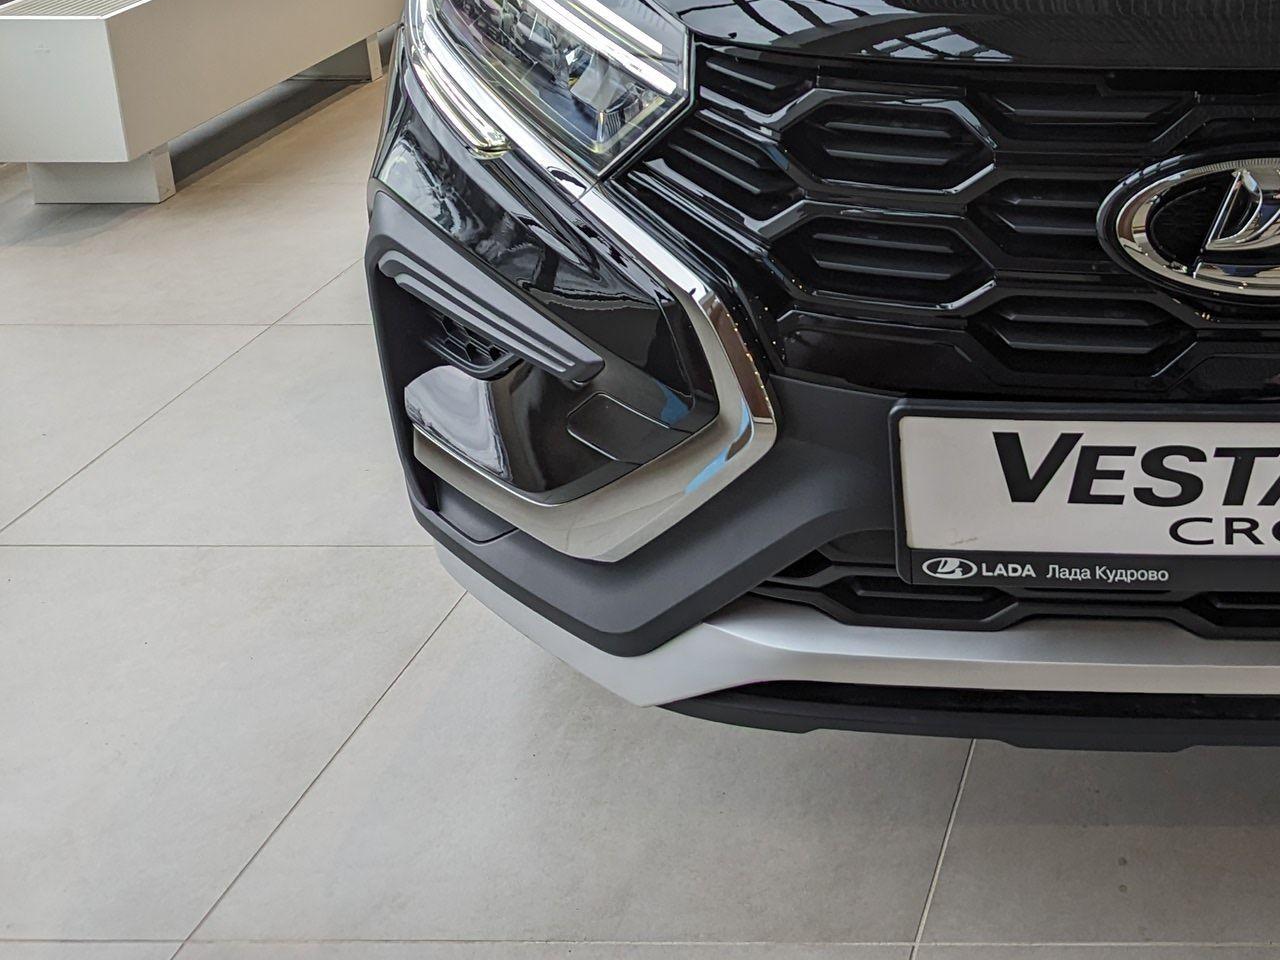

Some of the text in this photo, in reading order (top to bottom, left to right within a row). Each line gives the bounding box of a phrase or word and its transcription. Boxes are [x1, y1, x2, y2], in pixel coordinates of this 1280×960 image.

[981, 563, 1170, 583] LADA Лада Кудрово
